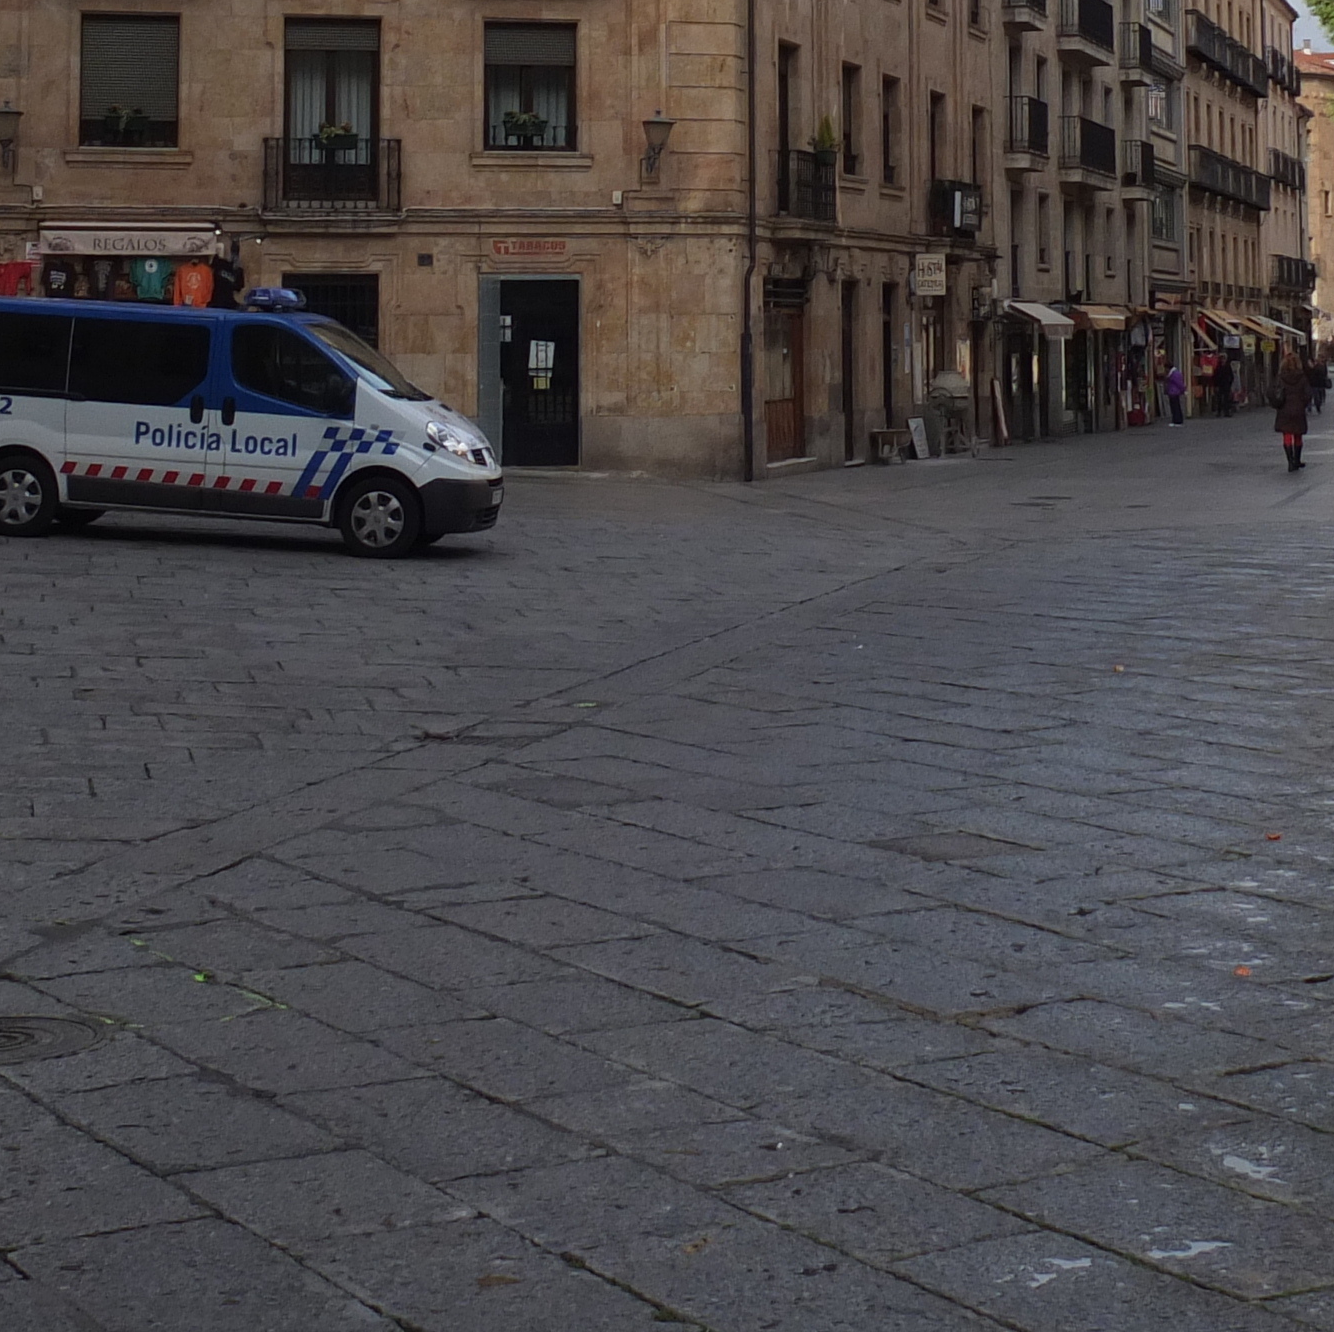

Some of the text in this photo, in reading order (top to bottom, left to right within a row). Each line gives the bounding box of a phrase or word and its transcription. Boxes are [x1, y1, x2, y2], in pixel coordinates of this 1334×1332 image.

[93, 237, 167, 252] REGALOS
[134, 420, 298, 457] Policía Local
